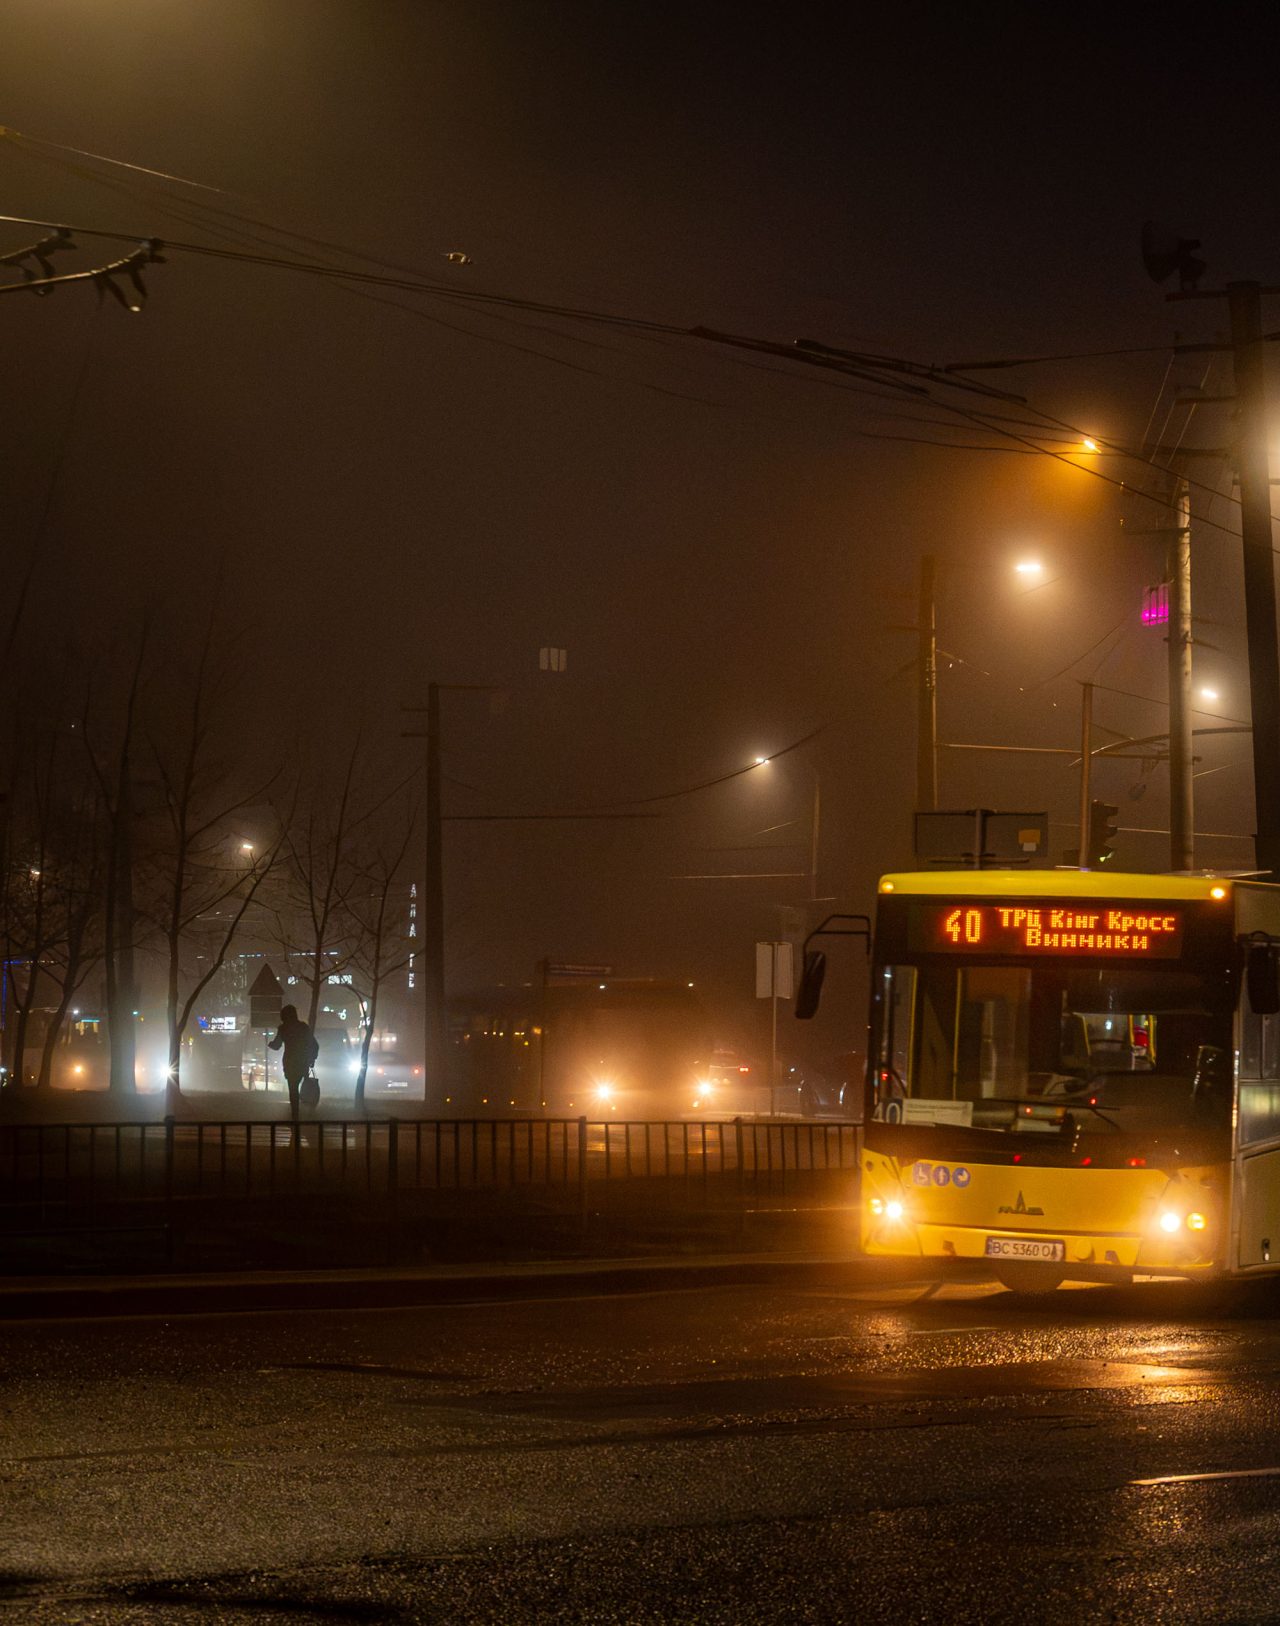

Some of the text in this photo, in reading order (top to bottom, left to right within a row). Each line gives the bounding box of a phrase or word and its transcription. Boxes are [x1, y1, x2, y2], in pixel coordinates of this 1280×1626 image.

[946, 909, 980, 943] 40
[998, 909, 1175, 932] ТРЦ Кінг Кросс
[1025, 928, 1149, 950] Винники
[992, 1241, 1010, 1255] BC
[1013, 1243, 1040, 1256] 5360
